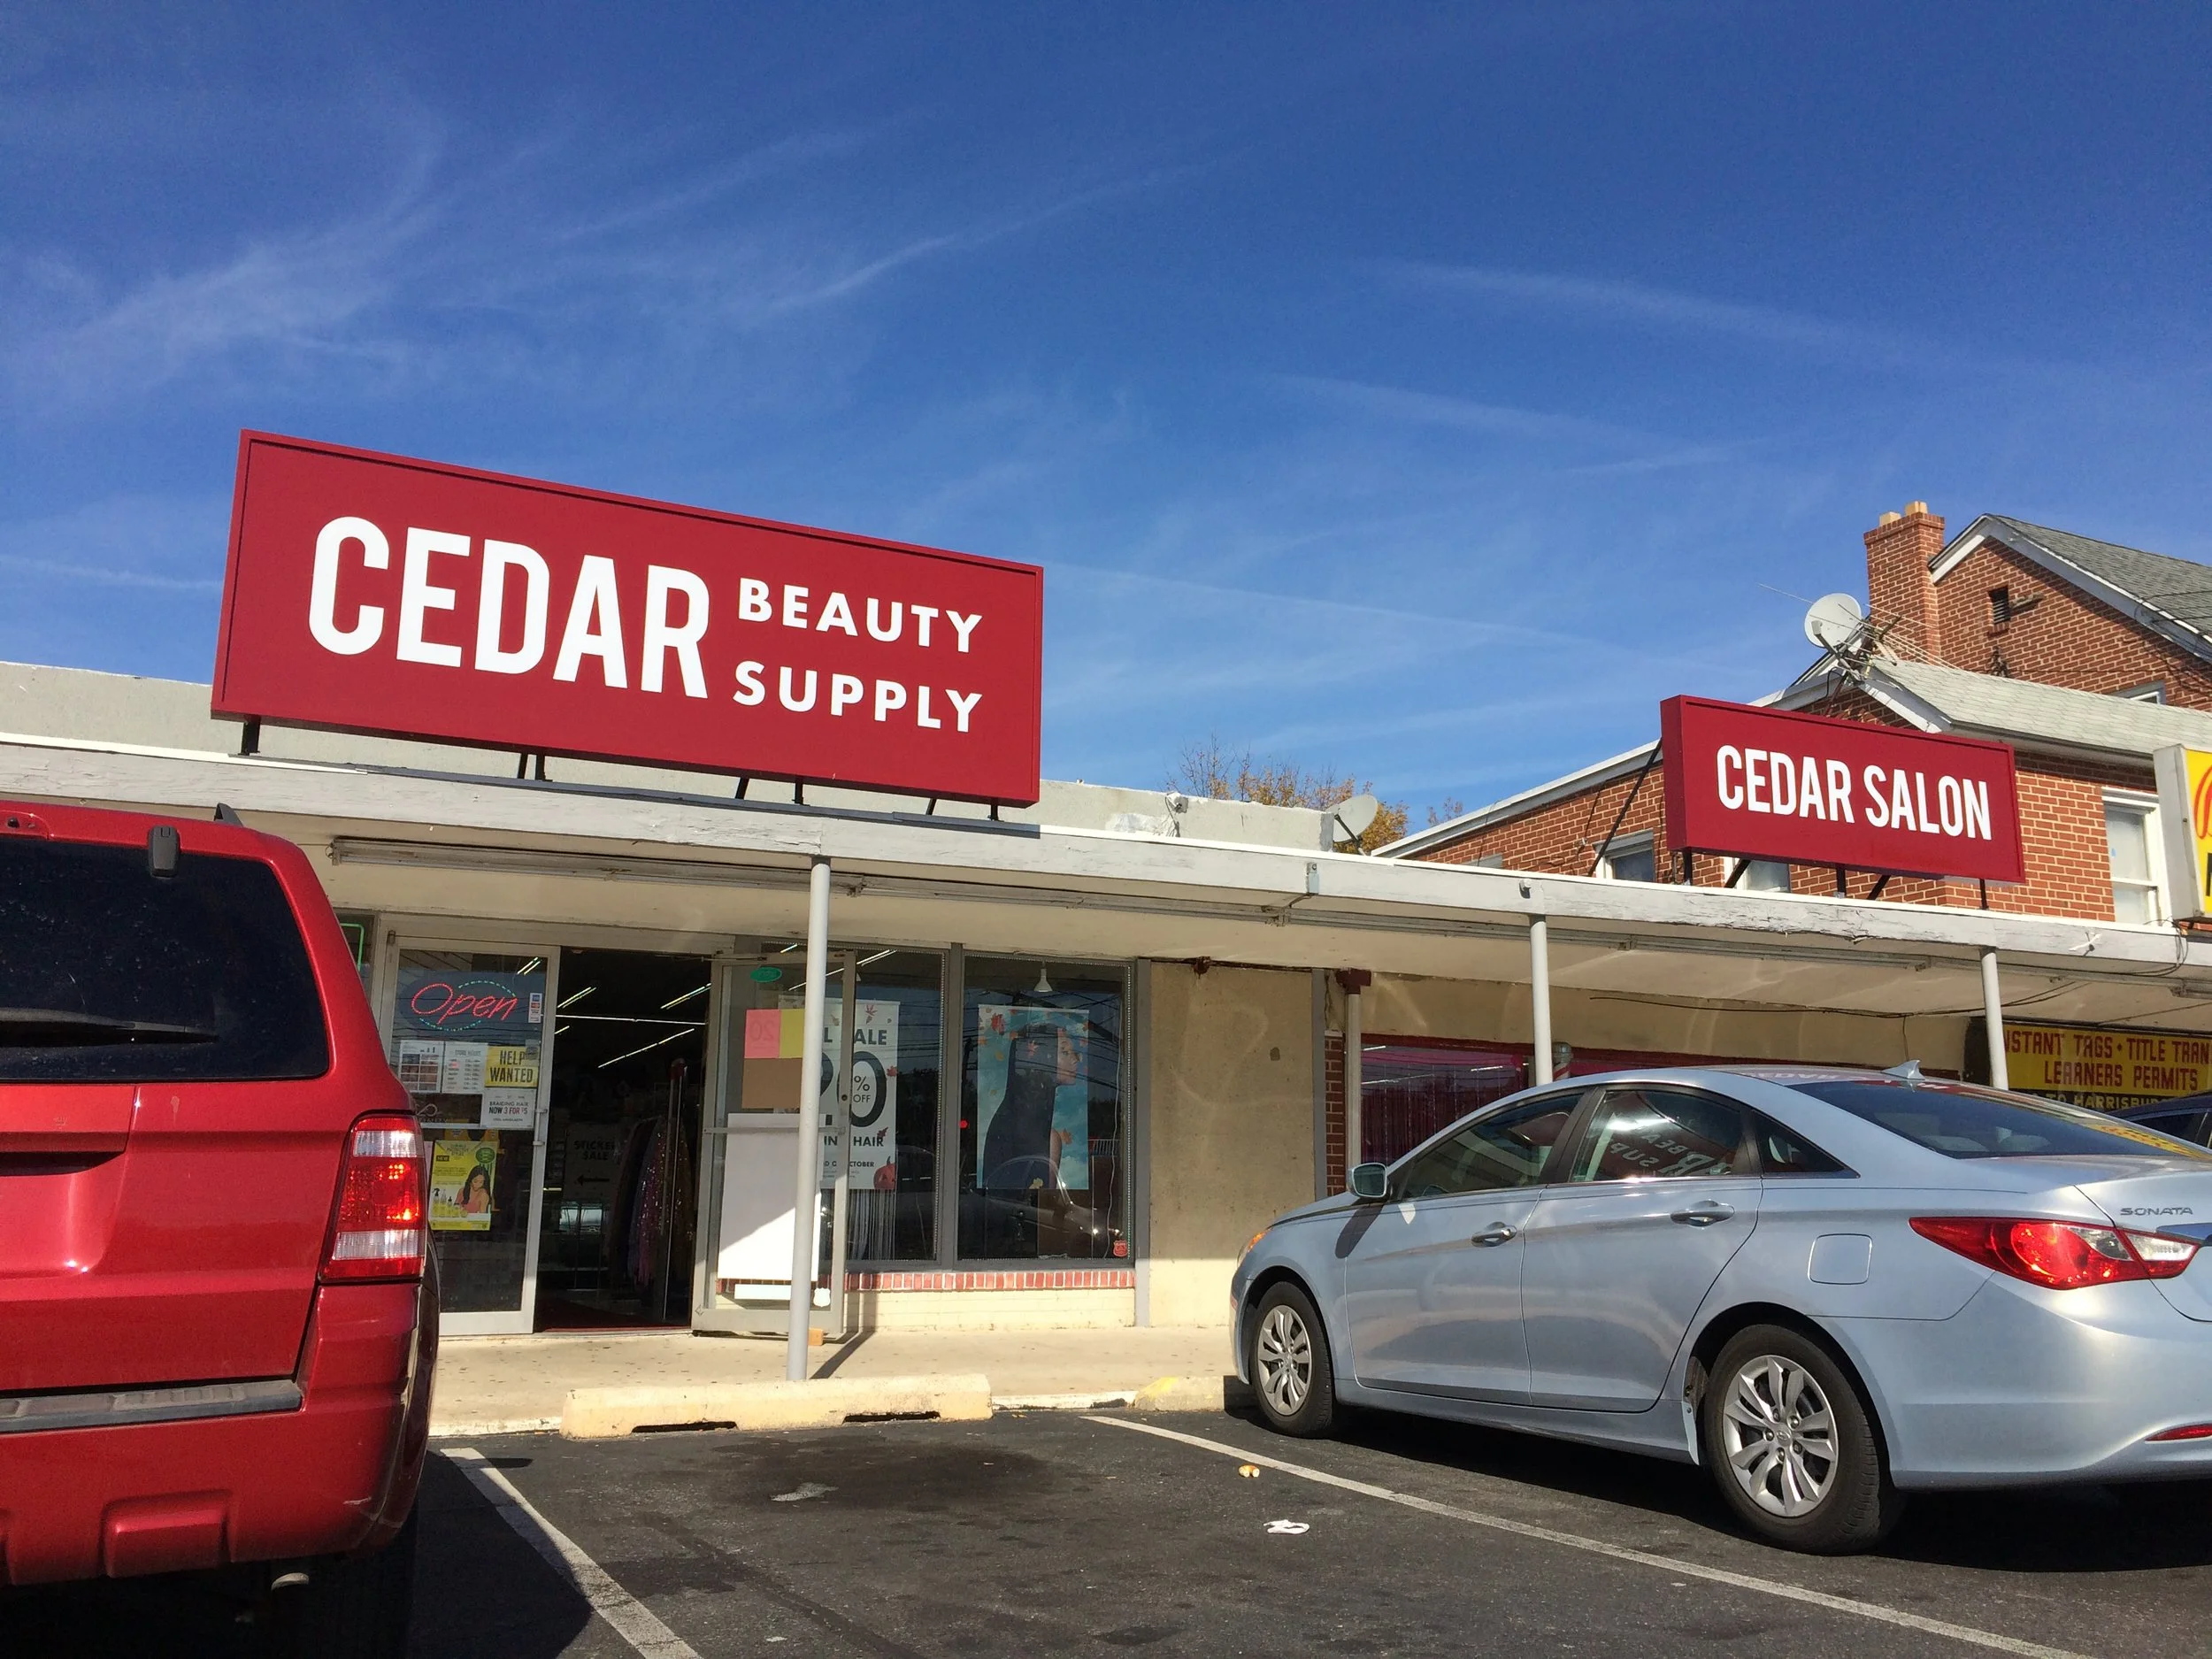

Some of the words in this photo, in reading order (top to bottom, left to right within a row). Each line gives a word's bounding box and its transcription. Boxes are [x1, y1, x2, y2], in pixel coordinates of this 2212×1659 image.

[308, 516, 710, 699] CEDAR
[738, 577, 983, 653] BEAUTY
[733, 660, 983, 733] SUPPLY
[1717, 744, 1855, 824] CEDAR
[1863, 764, 1992, 841] SALON
[411, 982, 518, 1025] Open
[853, 1028, 887, 1045] ALE
[2073, 1034, 2113, 1058] TAGS
[2126, 1038, 2165, 1061] TITLE
[2171, 1041, 2210, 1064] TRAN
[499, 1050, 527, 1065] HELP
[489, 1067, 534, 1083] WANTED
[2044, 1060, 2123, 1087] LEARNERS
[2133, 1065, 2199, 1091] PERMITS
[853, 1094, 872, 1103] OFF
[853, 1136, 884, 1147] HAIR
[2120, 1207, 2193, 1216] SONATA
